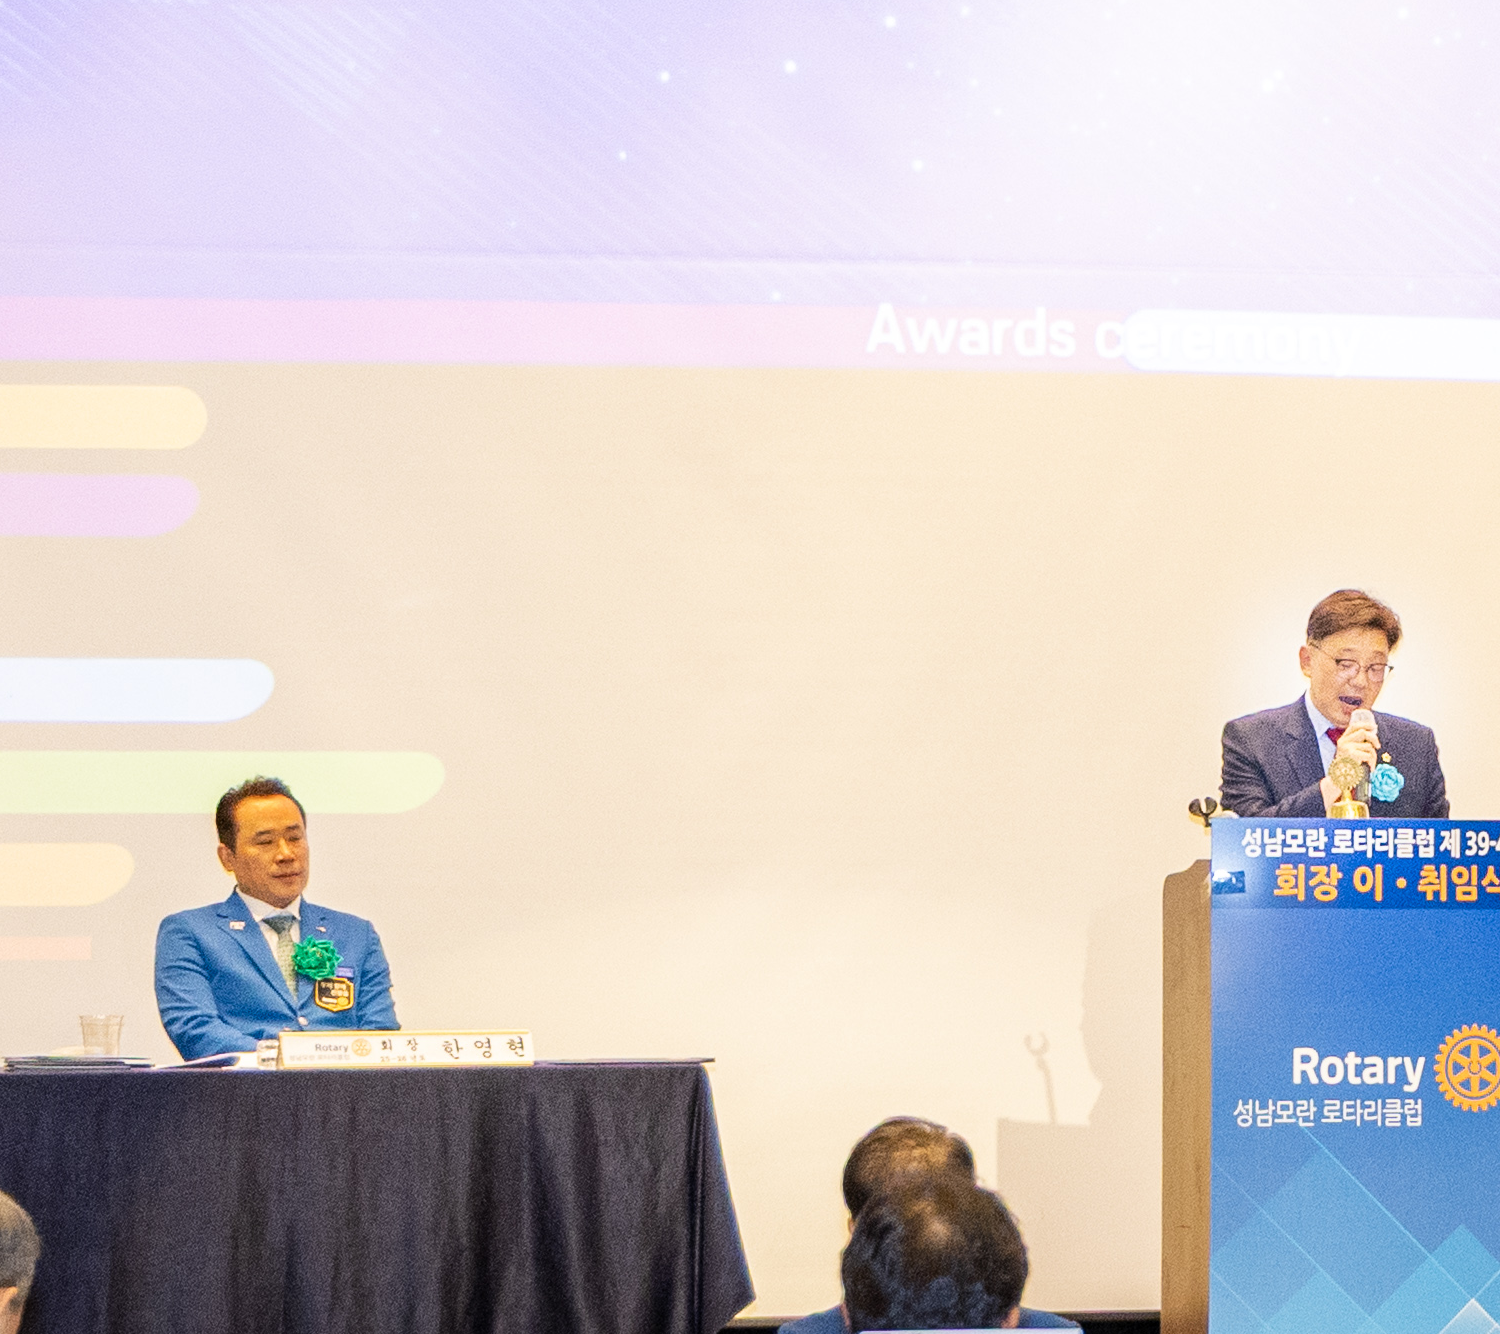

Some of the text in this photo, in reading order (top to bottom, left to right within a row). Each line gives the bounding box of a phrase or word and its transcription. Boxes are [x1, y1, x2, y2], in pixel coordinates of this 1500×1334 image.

[866, 302, 1076, 357] Awards
[1242, 828, 1327, 857] 성남모란
[1332, 828, 1434, 857] 로타리클럽
[1440, 829, 1460, 858] 제
[1274, 864, 1342, 901] 회장
[1353, 864, 1383, 901] 이
[315, 1043, 349, 1053] Rotary
[1293, 1048, 1425, 1092] Rotary
[1234, 1099, 1421, 1127] 성남모란 로타리클럽
